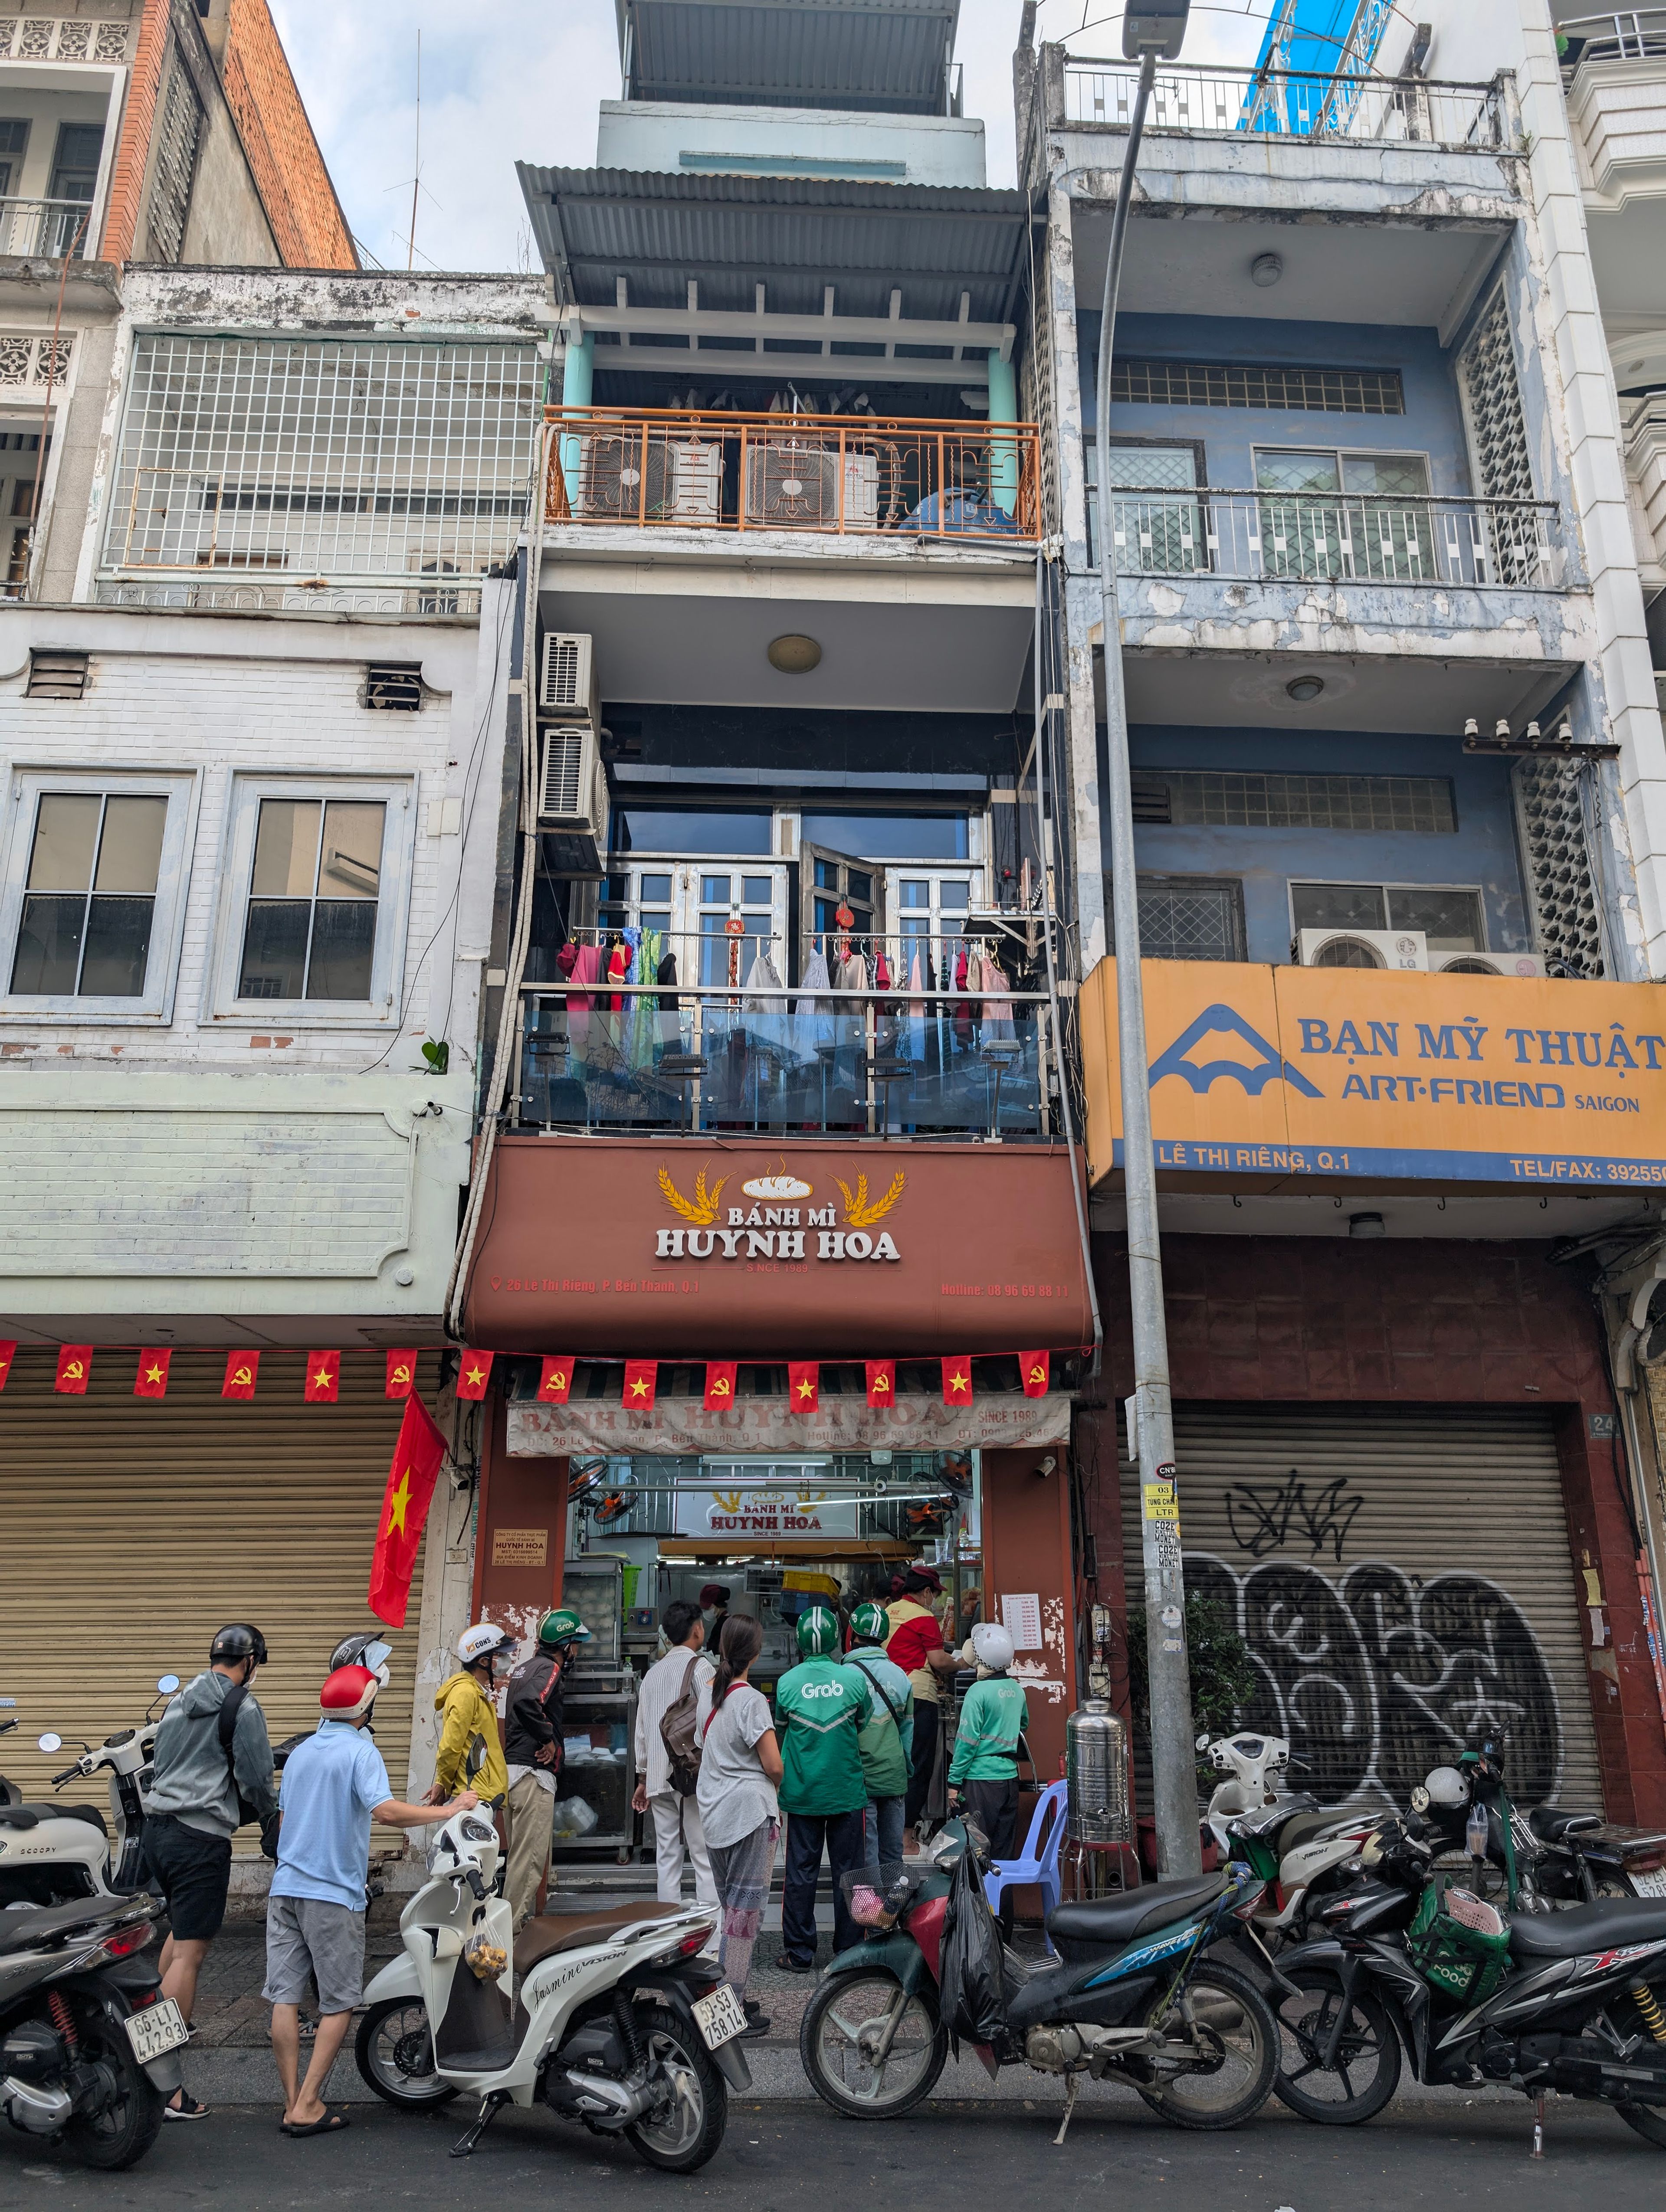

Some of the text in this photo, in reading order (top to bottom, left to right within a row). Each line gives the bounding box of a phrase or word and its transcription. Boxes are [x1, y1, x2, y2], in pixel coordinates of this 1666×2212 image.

[1399, 959, 1416, 969] LG
[1297, 1016, 1666, 1079] BẠN MỸ THUẬT
[1574, 1094, 1640, 1113] SAIGON
[1159, 1143, 1349, 1172] LÊ THỊ RIÊNG, Q.1
[1510, 1159, 1602, 1179] TEL/FAX:
[728, 1202, 836, 1227] BÁNH MÌ
[655, 1229, 901, 1260] HUYNH HOA
[746, 1263, 808, 1273] SNCE 1989
[506, 1278, 699, 1294] 26 Lê Thị Riêng, P. Bến Thành, Q.1
[941, 1283, 1069, 1298] Hotline: 08 96 69 88 11
[521, 1406, 617, 1432] BÁNH
[684, 1404, 845, 1430] HUYNH
[866, 1402, 950, 1427] HOA
[977, 1410, 1037, 1423] SINCE 1989
[1594, 1416, 1613, 1431] 24
[552, 1436, 566, 1446] 26
[571, 1436, 584, 1445] Lê
[672, 1433, 694, 1443] Bến
[698, 1433, 736, 1444] Thành,
[742, 1432, 761, 1442] Q.1
[807, 1430, 939, 1441] Hotline: 08 96 69 88 11
[958, 1430, 976, 1439] ĐT:
[744, 1502, 777, 1513] BÁNH
[1148, 1497, 1161, 1506] TÙNG
[711, 1516, 823, 1529] HUYNH HOA
[1155, 1520, 1175, 1531] COZE
[1154, 1534, 1175, 1544] MONET
[1158, 1545, 1178, 1554] COZE
[1158, 1559, 1178, 1568] MONET
[556, 1620, 575, 1633] Grab
[475, 1636, 492, 1649] CONS
[801, 1679, 844, 1699] Grab
[998, 1687, 1016, 1698] Grab
[1302, 1847, 1329, 1860] VISION
[1149, 1938, 1177, 1952] WAVE
[582, 1949, 628, 1967] VISION
[533, 1963, 583, 2013] Jasmine
[699, 1991, 731, 2023] 59-S3
[134, 2004, 172, 2037] 66-L1
[705, 2009, 743, 2045] 758.14
[136, 2022, 184, 2058] 442.93
